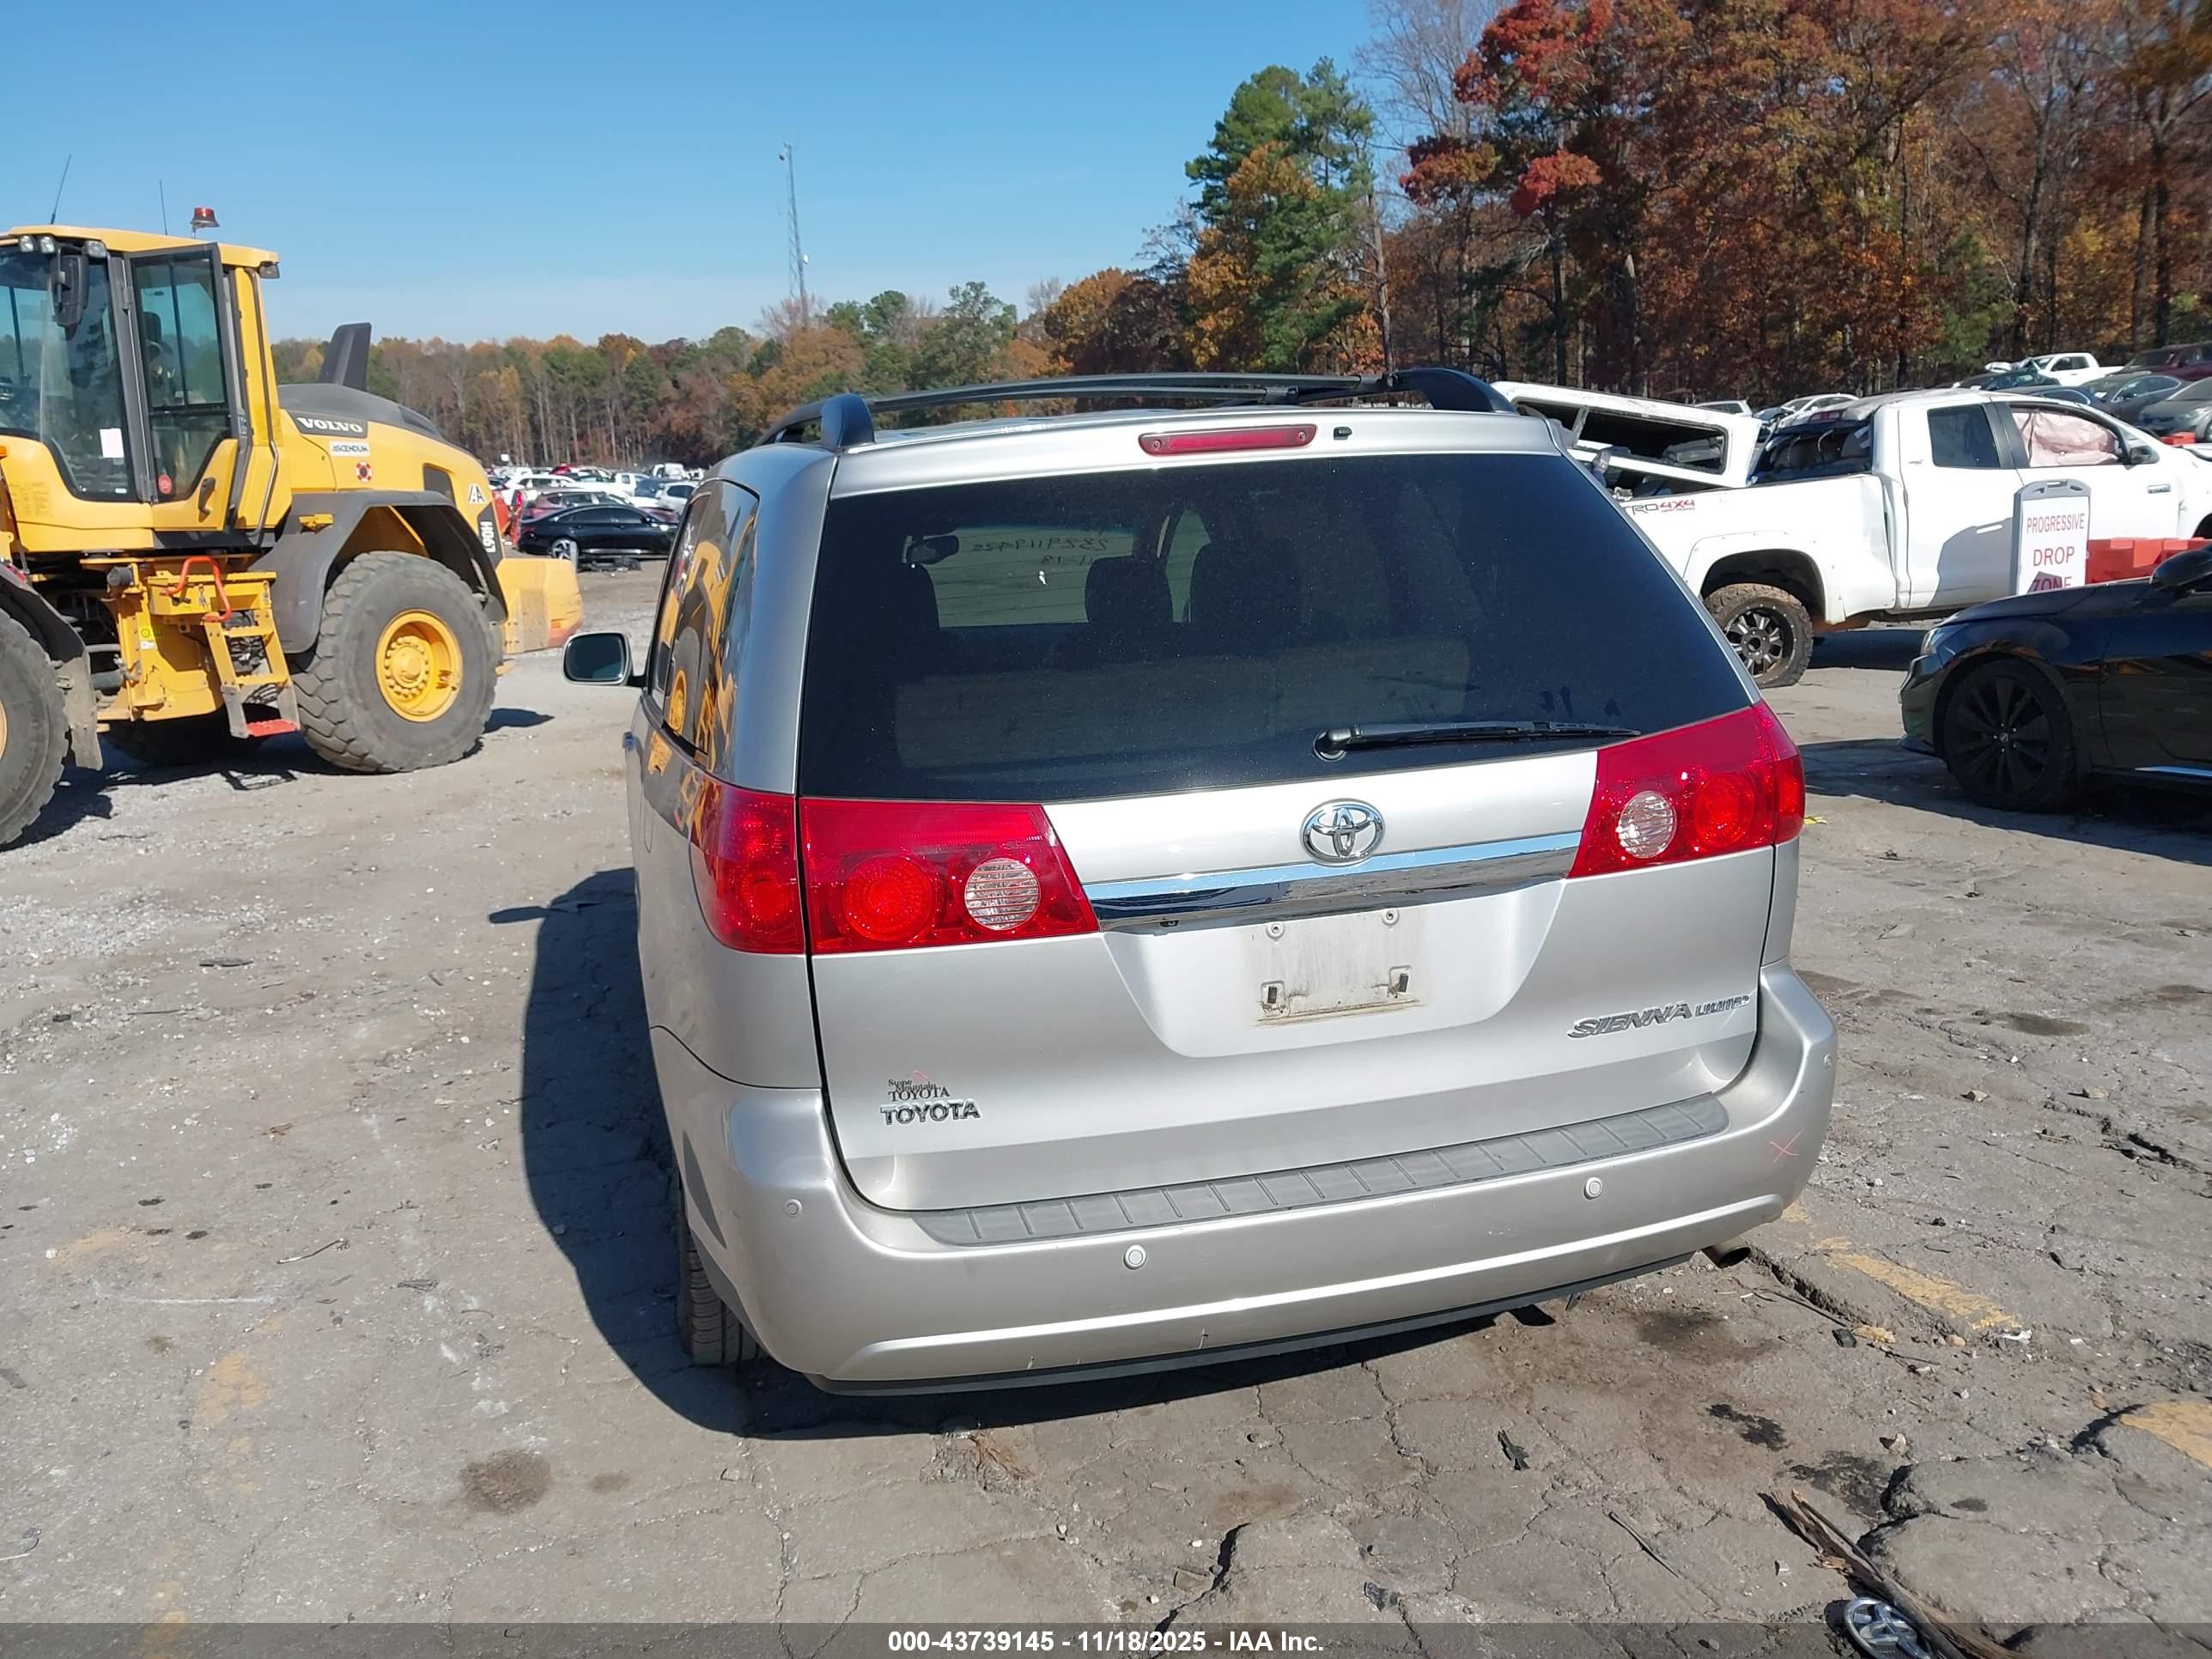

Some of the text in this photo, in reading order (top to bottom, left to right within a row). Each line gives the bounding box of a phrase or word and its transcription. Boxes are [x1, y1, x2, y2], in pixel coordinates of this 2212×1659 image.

[296, 417, 364, 434] VOLVO
[2027, 513, 2085, 534] PROGRESSIVE
[2033, 546, 2075, 567] DROP
[1567, 1001, 1693, 1039] SIENNA
[888, 1079, 913, 1087] Stone
[888, 1086, 951, 1102] TOYOTA
[880, 1098, 981, 1126] TOYOTA
